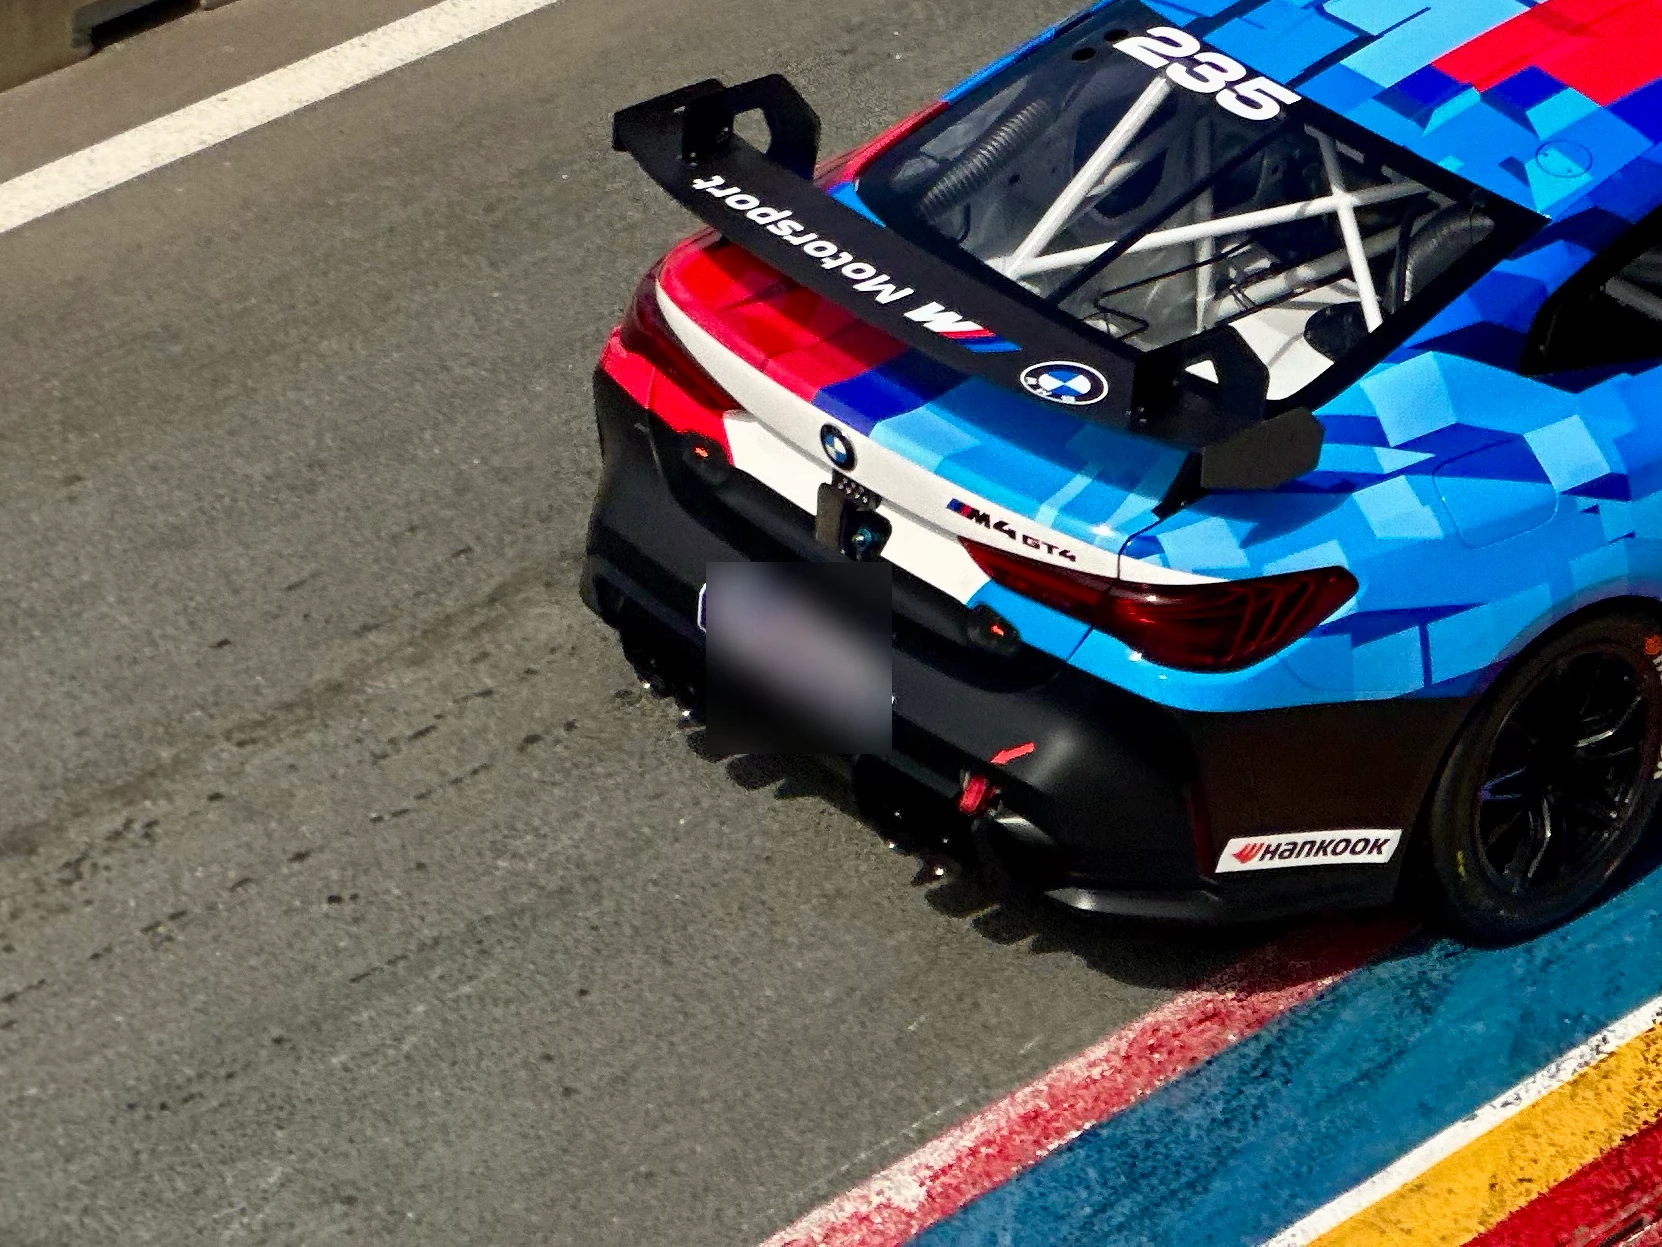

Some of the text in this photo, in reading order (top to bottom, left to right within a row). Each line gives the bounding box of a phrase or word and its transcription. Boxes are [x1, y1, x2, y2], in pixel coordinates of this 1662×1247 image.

[1112, 26, 1303, 121] 235
[692, 174, 914, 305] Motorsport
[965, 507, 1077, 563] M4 GT4
